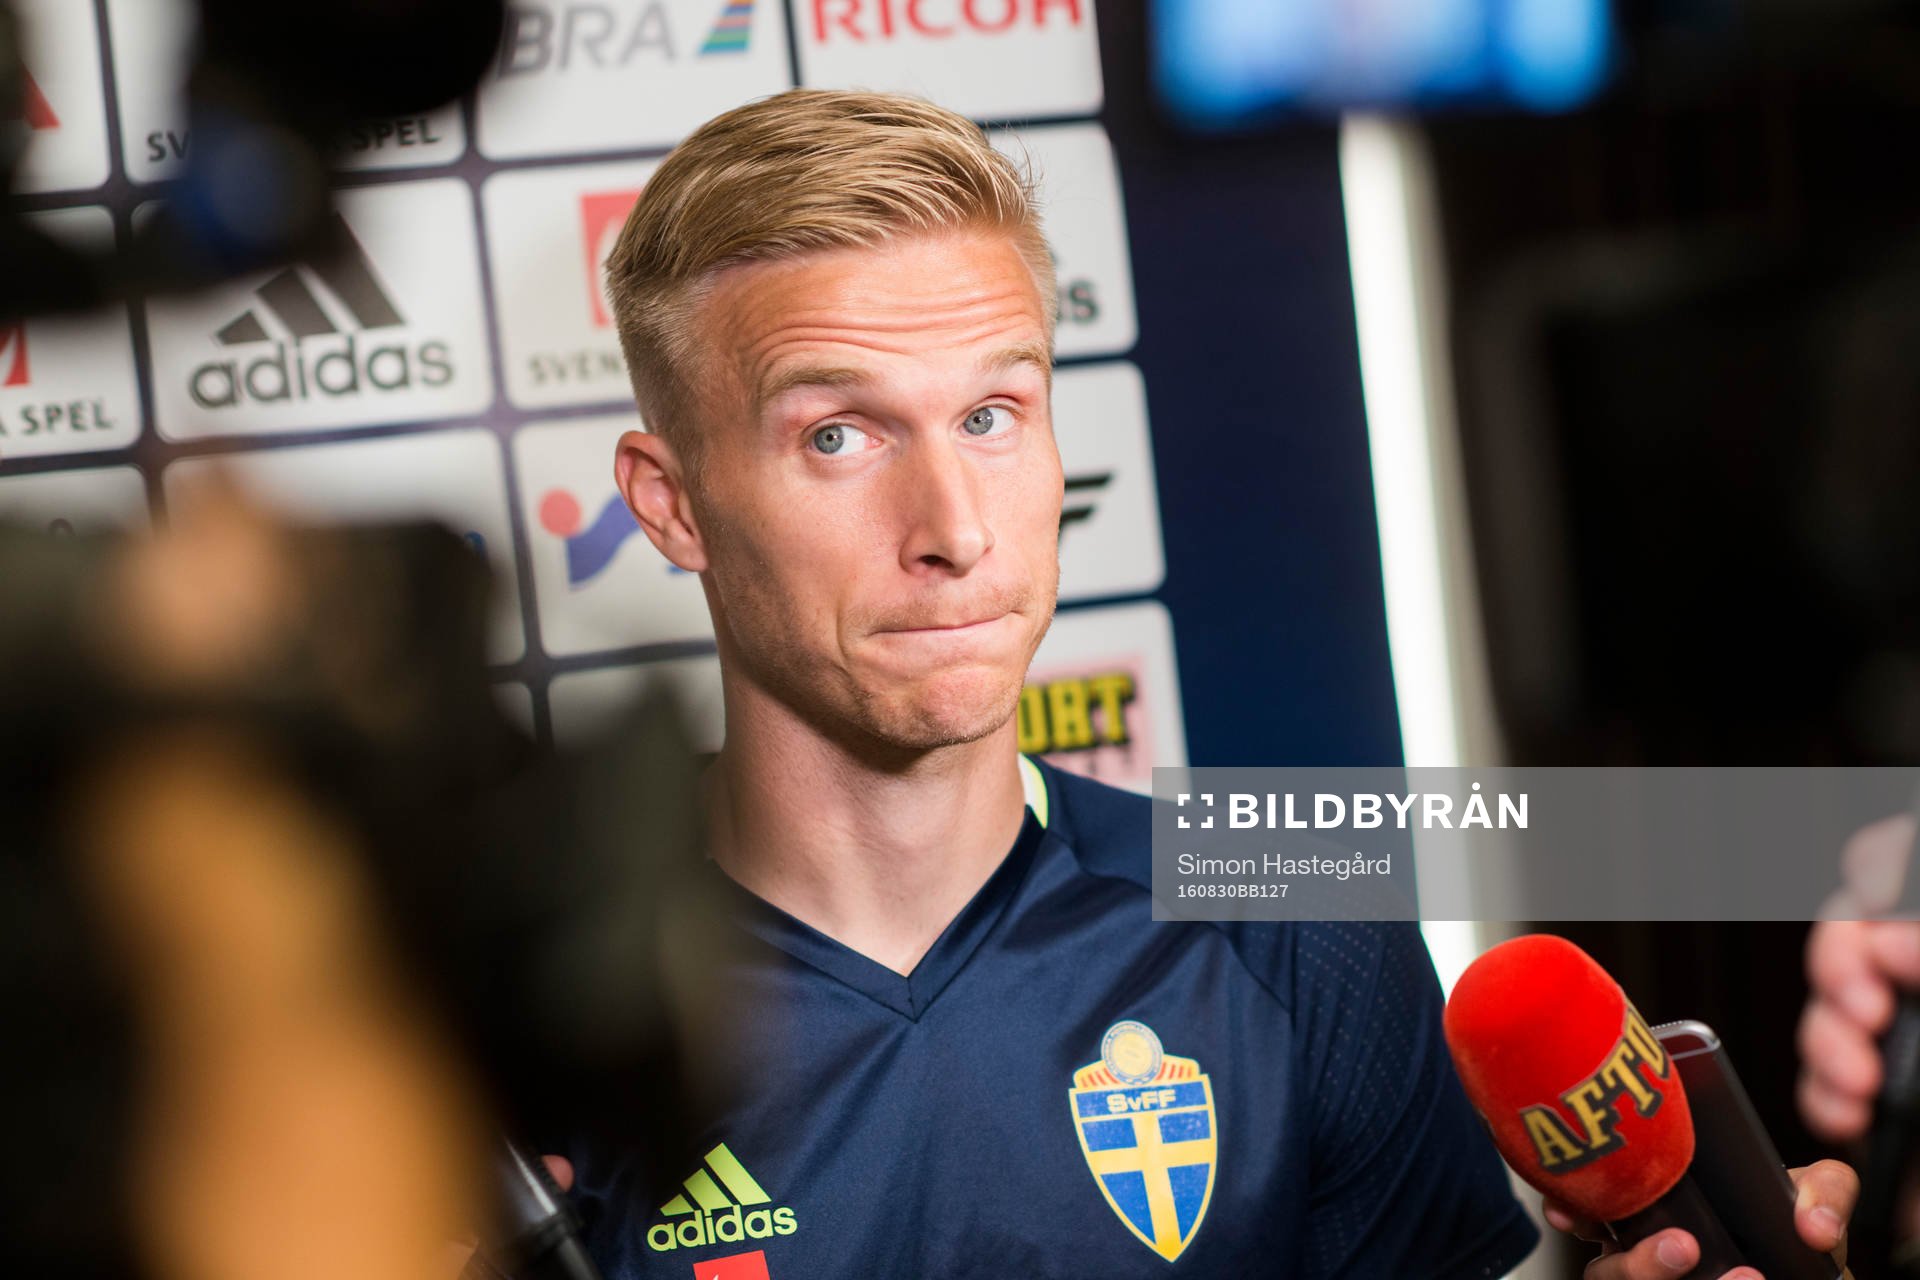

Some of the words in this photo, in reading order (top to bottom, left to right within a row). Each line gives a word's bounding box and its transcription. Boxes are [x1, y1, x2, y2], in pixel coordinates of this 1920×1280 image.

[188, 337, 456, 409] adidas
[529, 353, 622, 383] SVEN
[20, 401, 114, 434] SPEL
[1018, 671, 1137, 755] ORT
[1107, 1090, 1176, 1113] SvFF
[1521, 1004, 1669, 1174] AFTO
[647, 1204, 798, 1251] adidas
